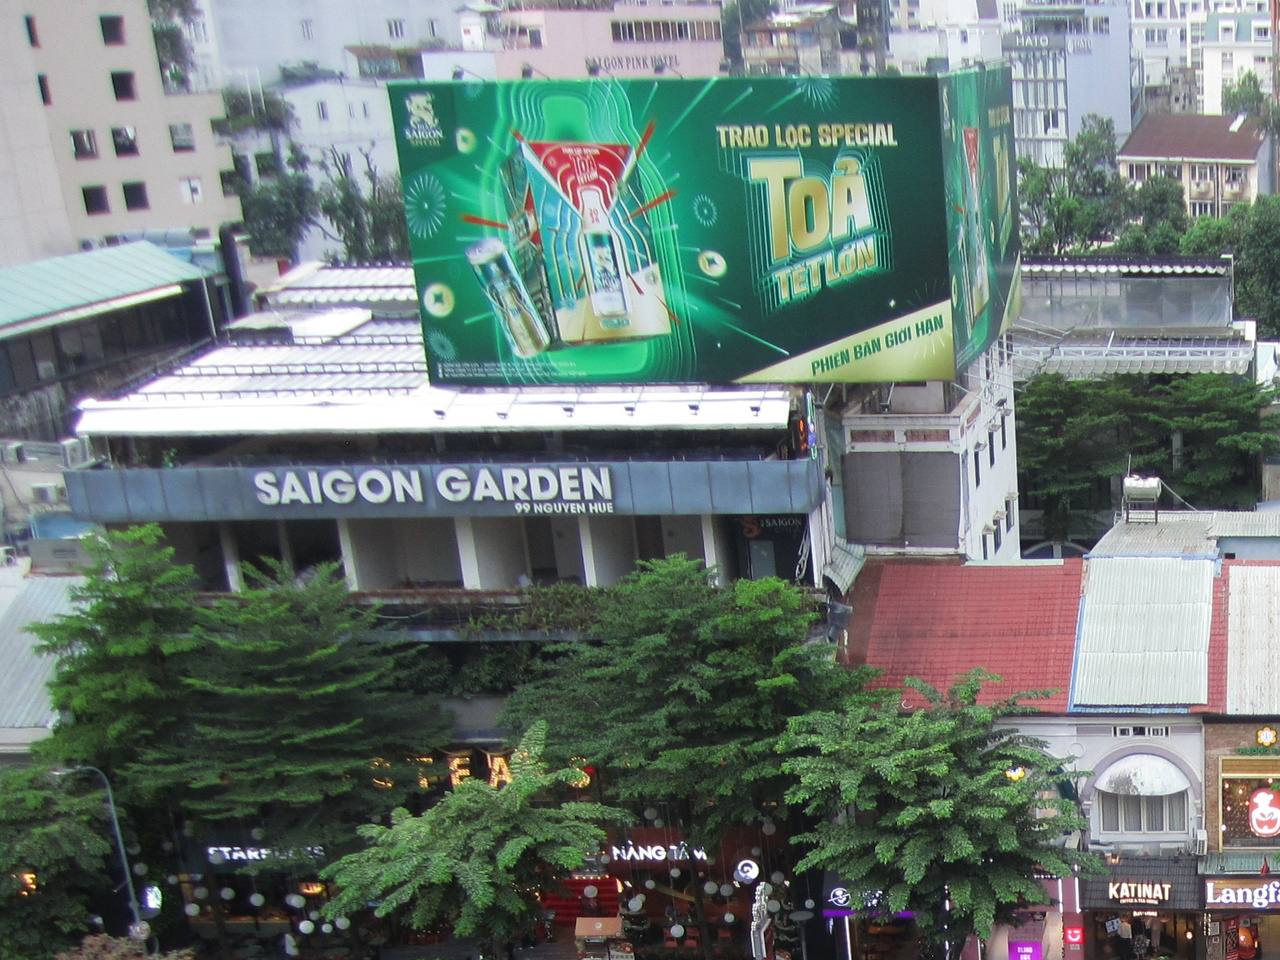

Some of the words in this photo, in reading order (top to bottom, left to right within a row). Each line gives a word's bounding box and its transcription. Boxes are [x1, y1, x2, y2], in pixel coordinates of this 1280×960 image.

[626, 55, 649, 70] PINK
[404, 128, 443, 139] SAIGON
[716, 124, 769, 148] TRAO
[818, 122, 898, 147] SPECIAL
[254, 469, 424, 505] SAIGON
[436, 467, 613, 501] GARDEN
[515, 503, 530, 514] 99
[533, 503, 587, 514] NGUYEN
[589, 502, 613, 514] HUE
[612, 840, 667, 861] NÀNG
[1108, 882, 1172, 901] KATINAT
